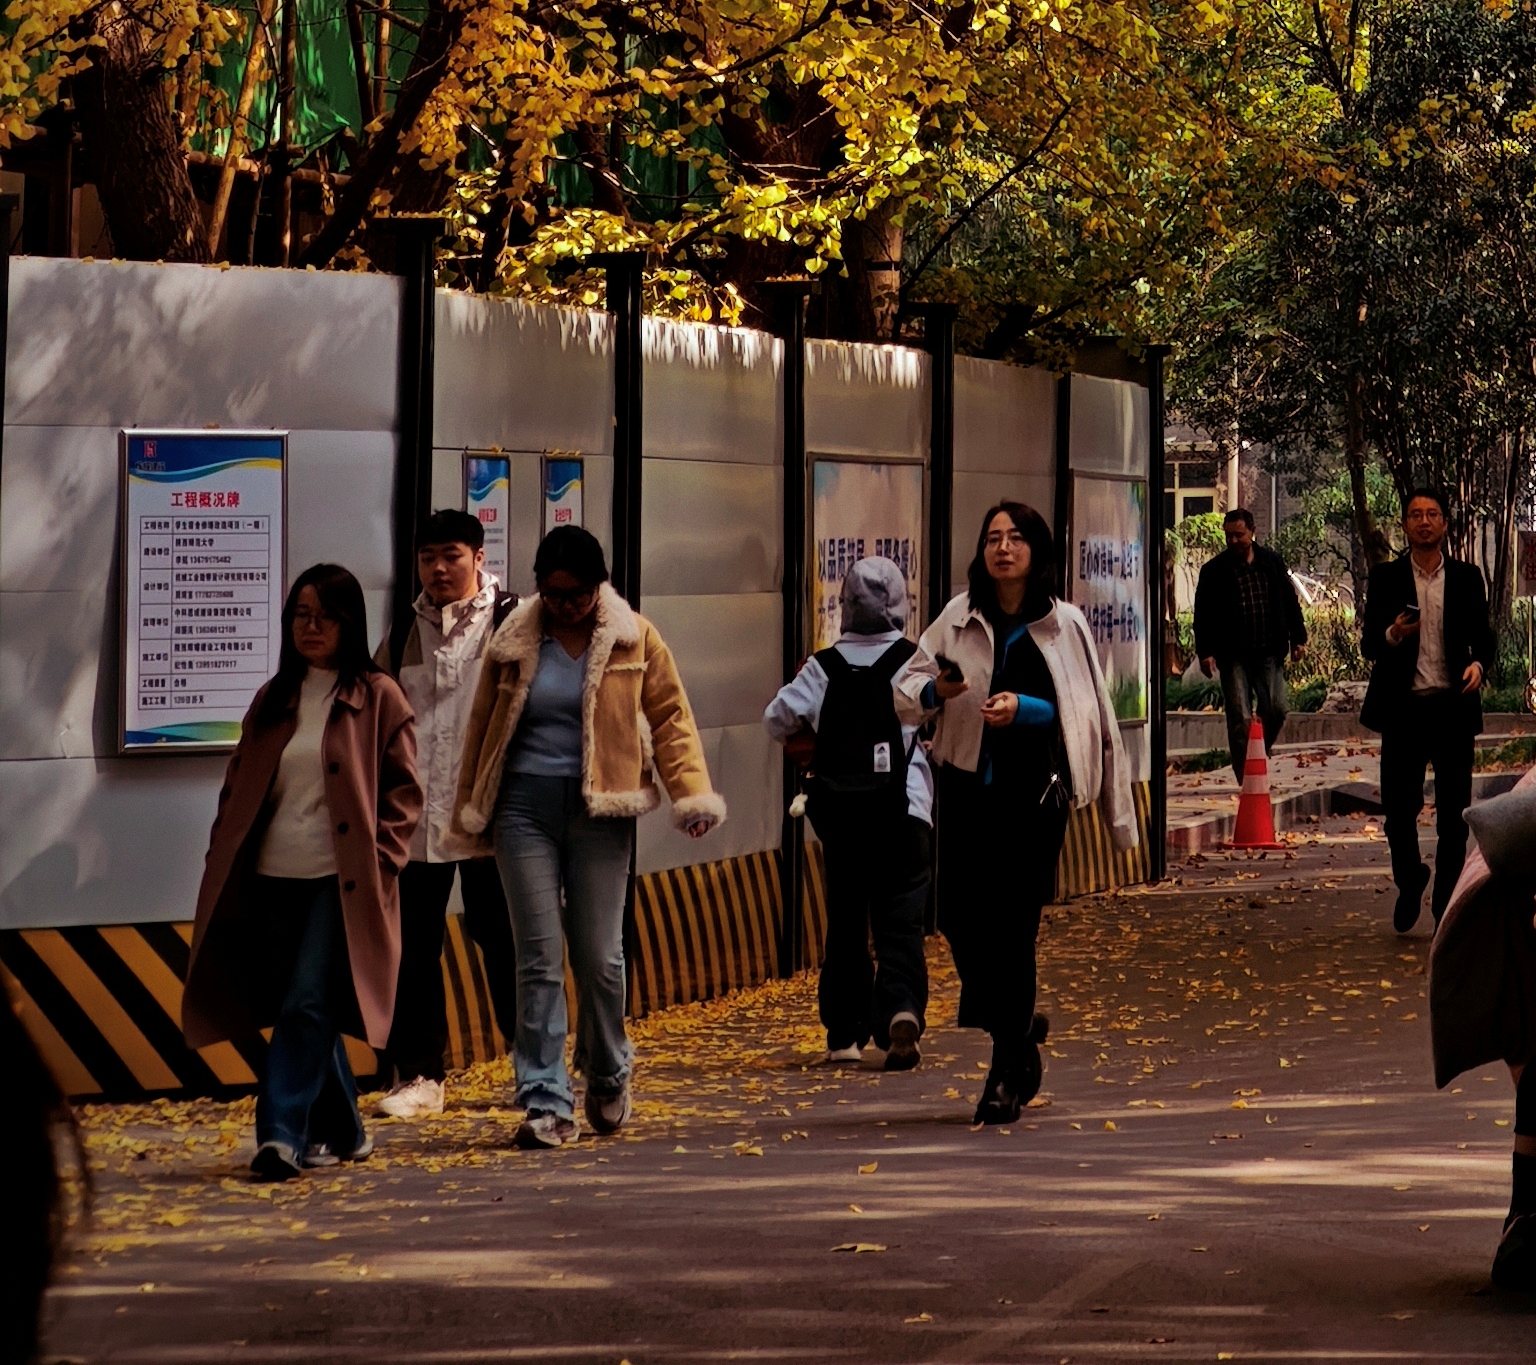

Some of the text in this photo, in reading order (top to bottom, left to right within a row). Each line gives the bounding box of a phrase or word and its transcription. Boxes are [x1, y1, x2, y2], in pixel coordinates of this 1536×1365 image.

[171, 491, 241, 508] 工程概况牌
[144, 521, 170, 529] 工程名称
[175, 538, 214, 547] 陕西师范大学
[144, 547, 170, 556] 建设单位
[143, 582, 169, 590] 设计单位
[143, 618, 169, 626] 监理单位
[142, 653, 168, 661] 施工单位
[142, 678, 187, 688] 工程质量 合格
